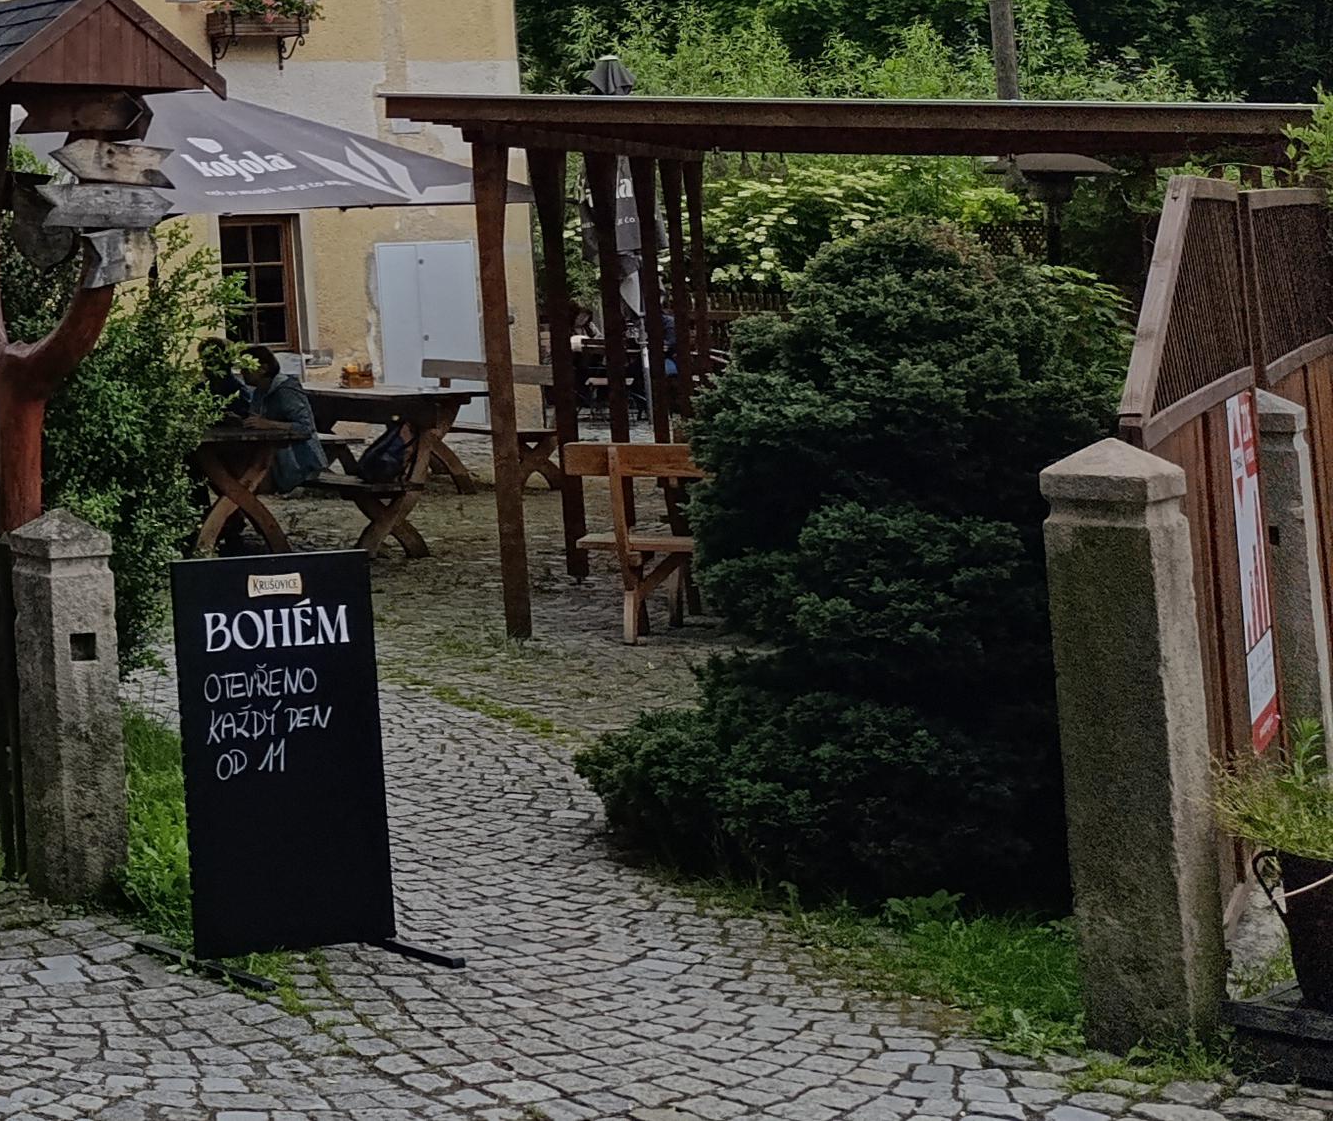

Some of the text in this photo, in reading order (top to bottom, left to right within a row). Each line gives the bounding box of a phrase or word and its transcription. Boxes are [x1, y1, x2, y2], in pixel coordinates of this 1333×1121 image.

[180, 151, 297, 182] kofola
[204, 598, 350, 652] BOHÉM
[204, 663, 318, 703] OTEVŘENO
[207, 699, 333, 745] KAŽDÝ DEN
[216, 738, 286, 781] OD 11
